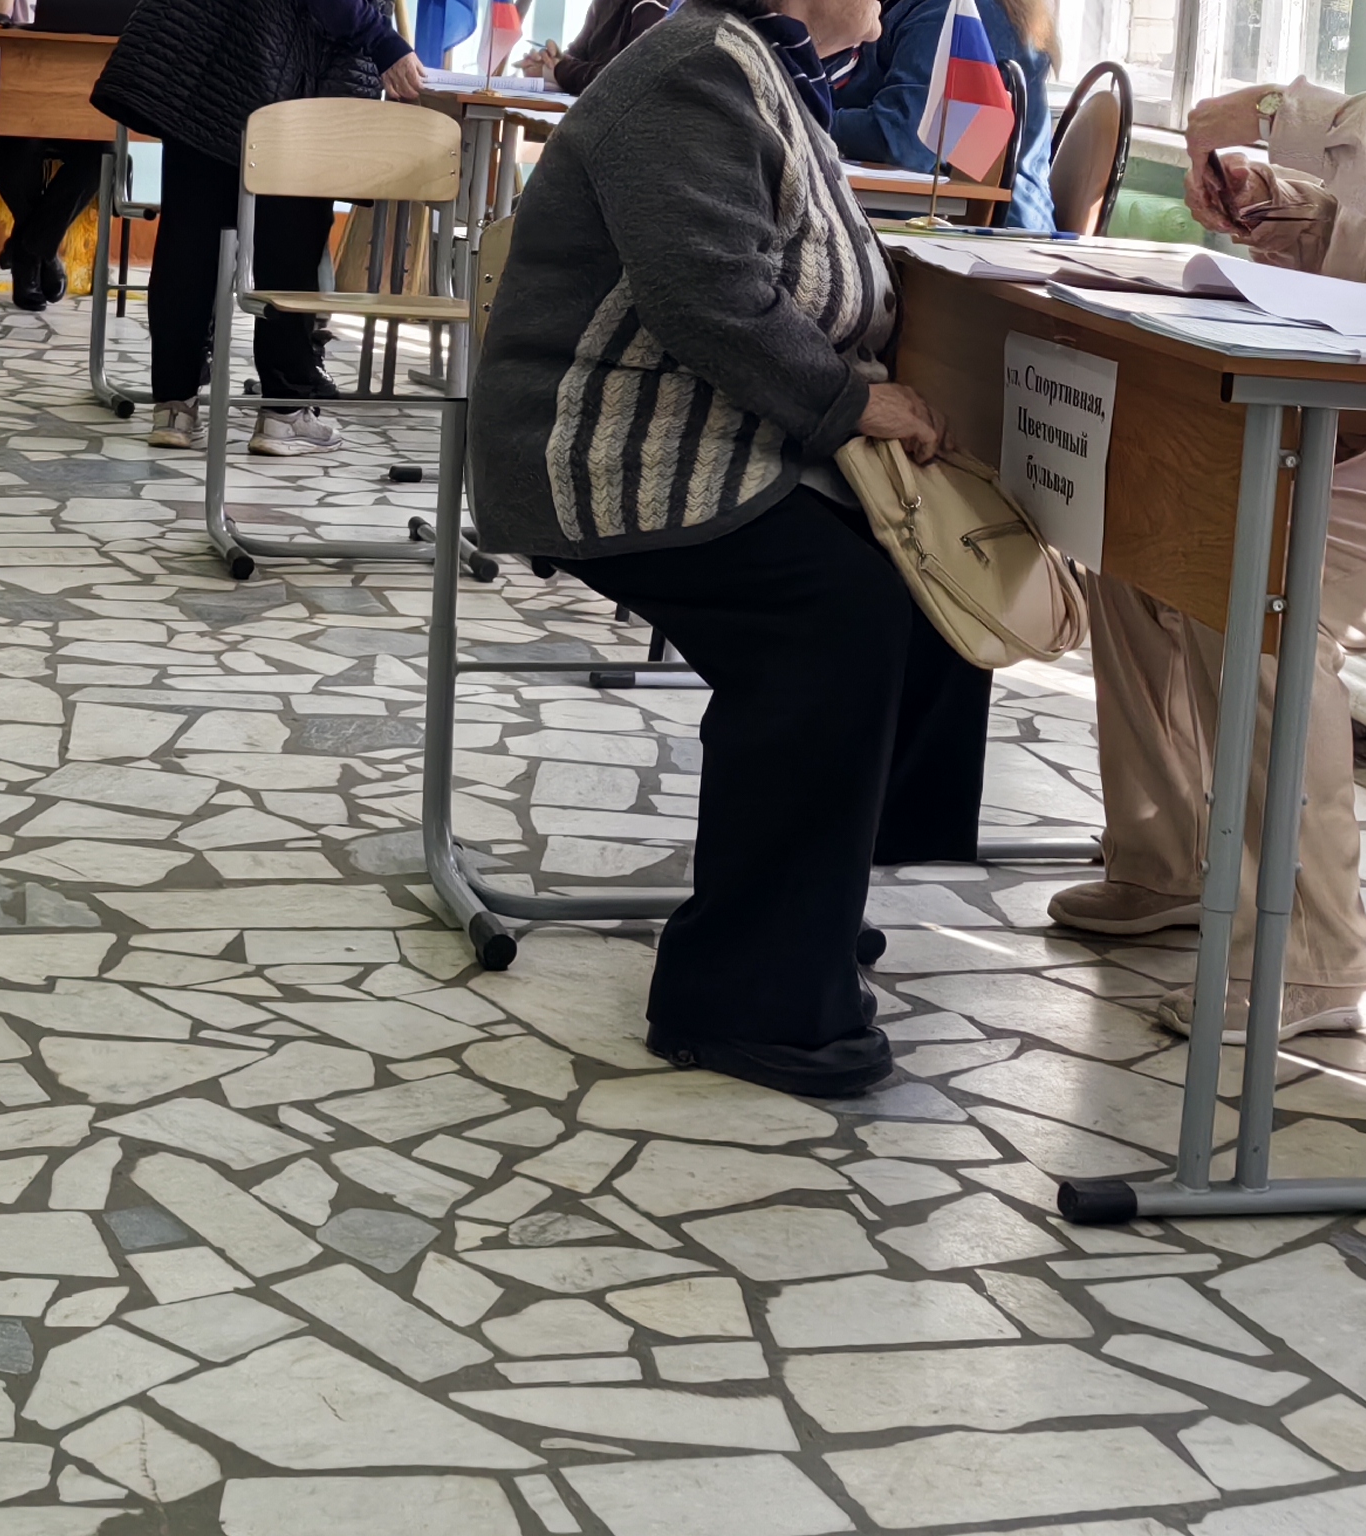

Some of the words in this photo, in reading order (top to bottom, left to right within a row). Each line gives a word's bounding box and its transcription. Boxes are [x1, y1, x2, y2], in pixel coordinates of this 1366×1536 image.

[1025, 365, 1105, 422] Спортивная,
[1017, 406, 1088, 458] Цветочный
[1026, 454, 1074, 505] бульвар
